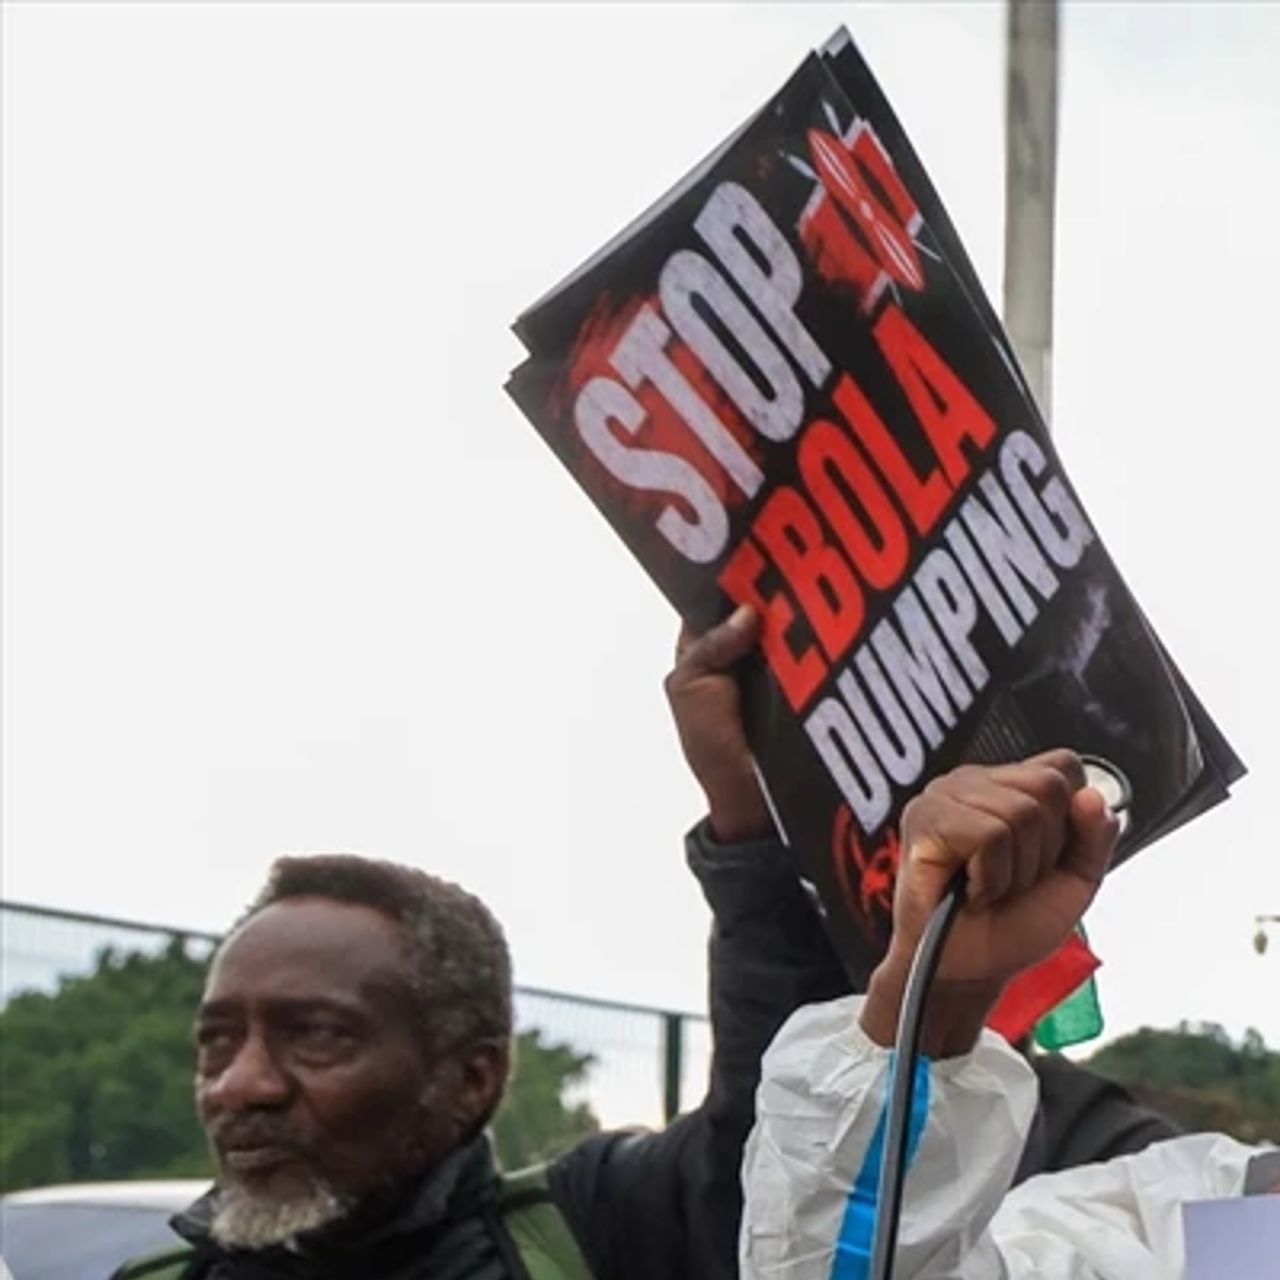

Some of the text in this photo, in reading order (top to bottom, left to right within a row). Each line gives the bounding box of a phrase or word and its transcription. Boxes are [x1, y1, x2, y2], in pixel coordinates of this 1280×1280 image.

[572, 181, 833, 564] STOP
[716, 302, 998, 712] EBOLA
[803, 428, 1097, 837] DUMPING
